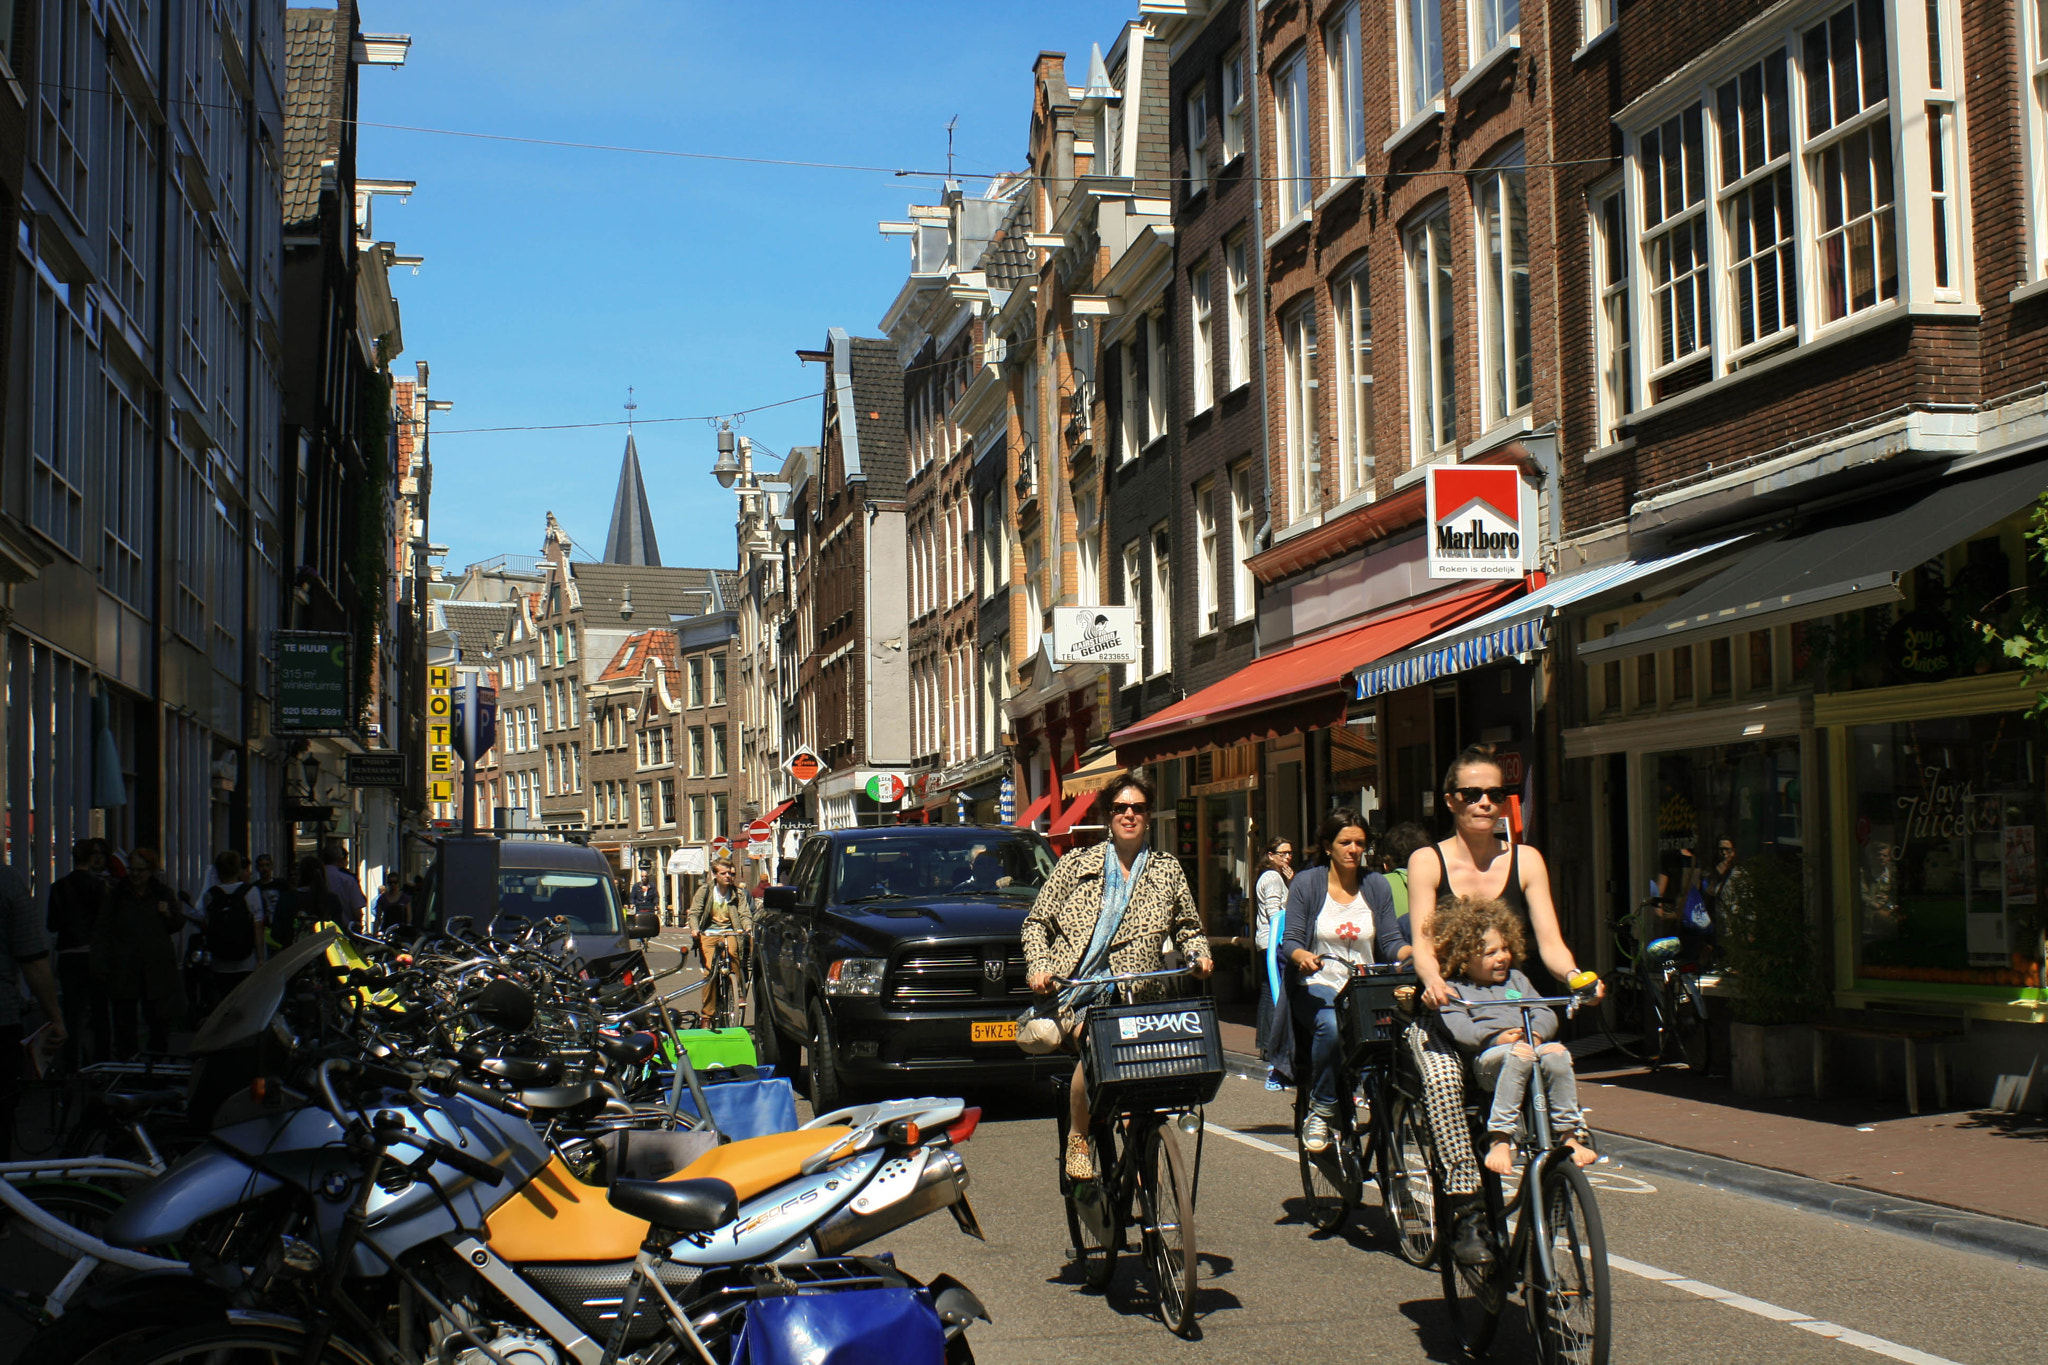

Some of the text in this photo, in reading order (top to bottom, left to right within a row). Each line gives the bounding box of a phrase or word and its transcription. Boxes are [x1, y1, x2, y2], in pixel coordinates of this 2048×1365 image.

[1436, 519, 1520, 550] Marlboro
[1439, 565, 1516, 574] Roken is dodelijk
[283, 643, 328, 653] TE HUUR
[1071, 631, 1117, 652] HAIRSTUDIO
[1080, 637, 1122, 657] GEORGE
[1905, 626, 1945, 650] Jay's
[1901, 650, 1950, 673] Juices
[282, 668, 302, 679] 315
[282, 680, 343, 691] winkelruimte
[282, 707, 342, 716] 020 626 2691
[430, 668, 449, 801] HOTEL
[1919, 765, 1976, 816] Jay's
[1890, 796, 1977, 862] Juices
